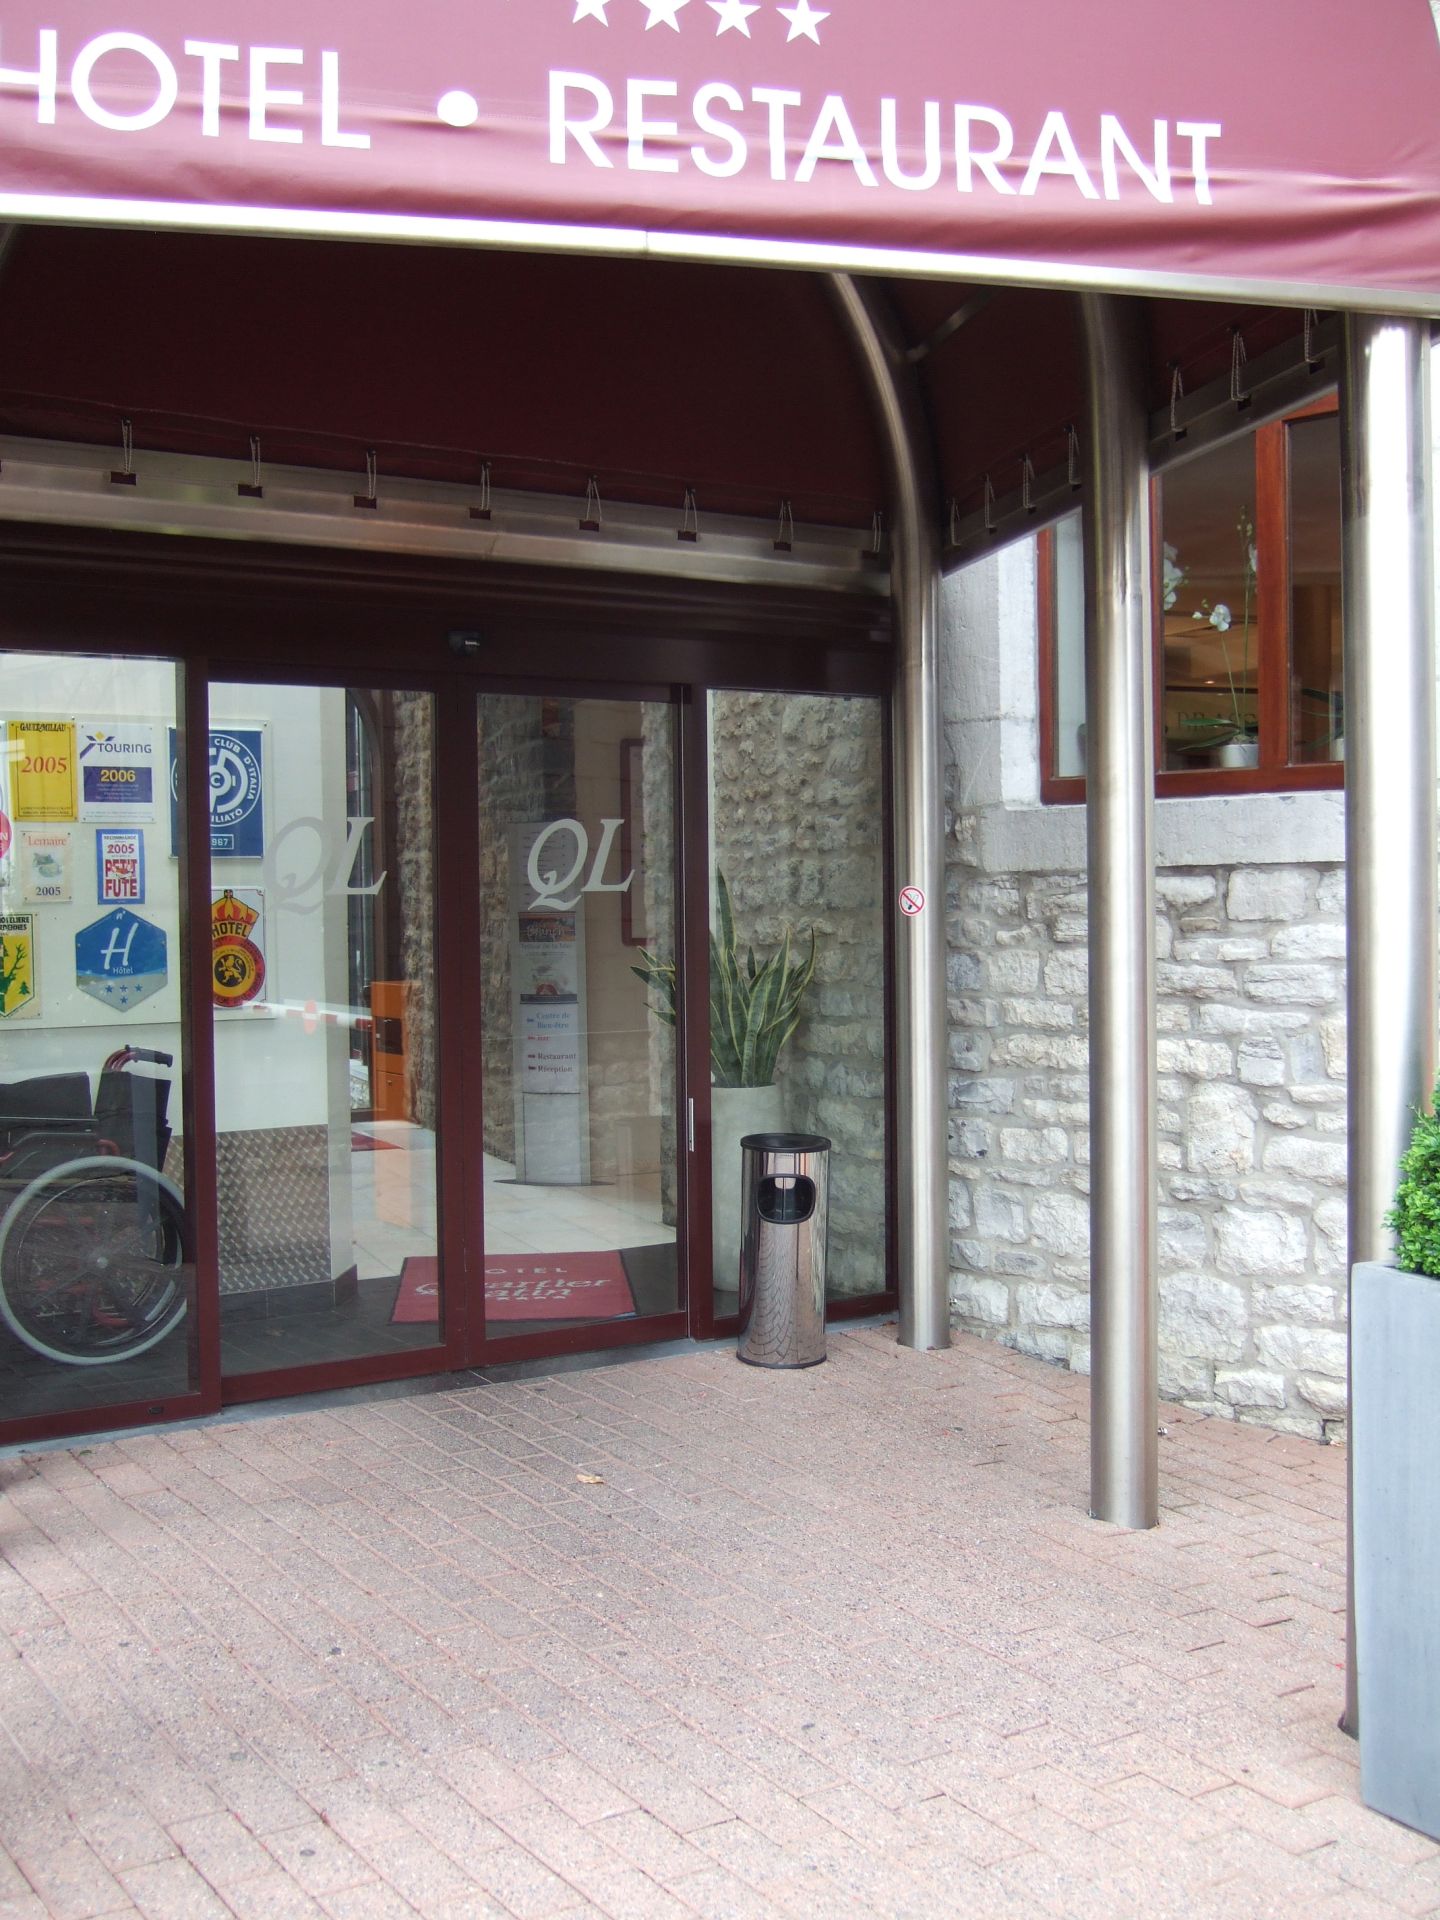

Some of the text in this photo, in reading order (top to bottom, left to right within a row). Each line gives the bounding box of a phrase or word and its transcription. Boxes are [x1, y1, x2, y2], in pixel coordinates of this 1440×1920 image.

[0, 28, 1222, 206] HOTEL RESTAURANT
[97, 743, 152, 753] TOURING
[21, 756, 68, 773] 2005
[214, 738, 257, 800] CLUB D'ITALIA
[100, 769, 136, 782] 2006
[210, 808, 243, 823] ILIATO
[28, 836, 67, 846] Lemaire
[107, 844, 135, 854] 2005
[527, 818, 636, 911] QL
[36, 887, 61, 896] 2005
[212, 921, 248, 938] HOTEL
[101, 922, 139, 970] H
[112, 967, 134, 975] Hôtel
[537, 1052, 576, 1060] Restaurant
